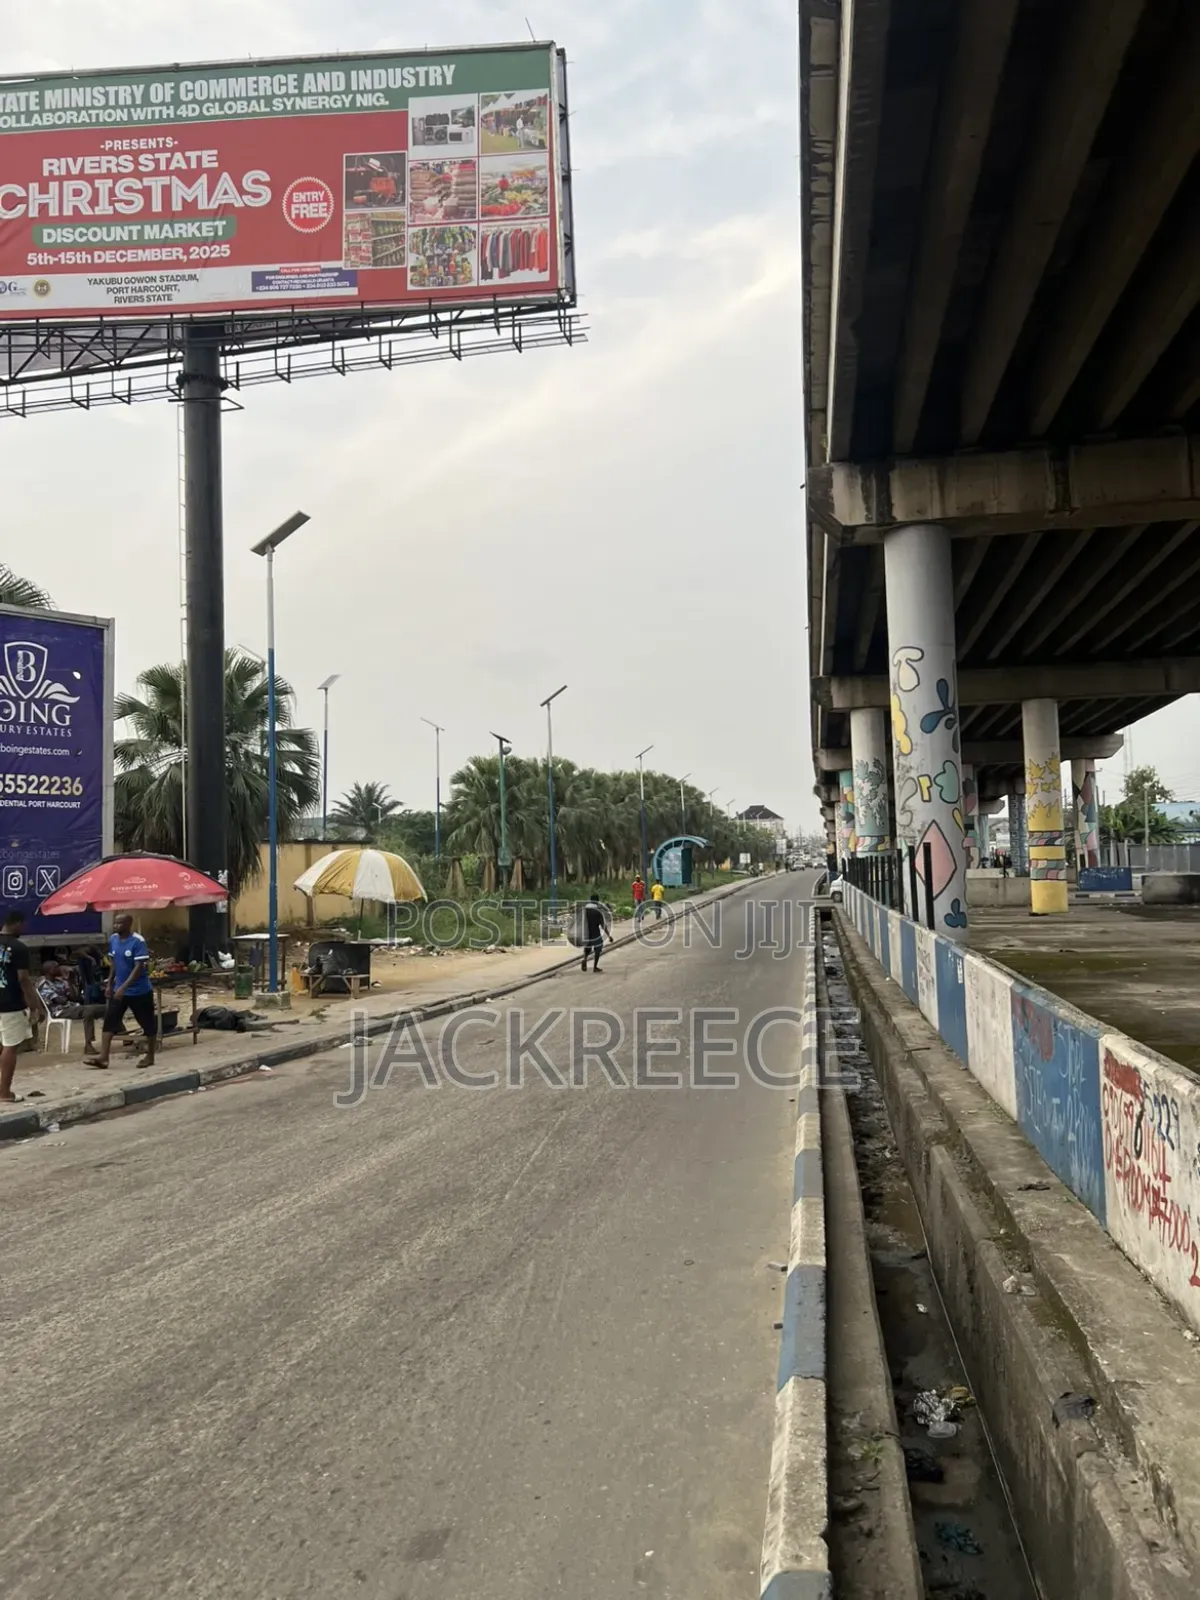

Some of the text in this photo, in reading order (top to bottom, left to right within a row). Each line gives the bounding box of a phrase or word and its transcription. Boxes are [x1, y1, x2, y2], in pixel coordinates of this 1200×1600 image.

[44, 84, 146, 110] MINISTRY
[150, 79, 176, 103] OF
[180, 73, 299, 100] COMMERCE
[302, 70, 346, 94] AND
[351, 64, 456, 91] INDUSTRY
[0, 92, 389, 129] OLLABORATION WITH 4D GLOBAL SYNERGY NIG.
[42, 149, 219, 177] RIVERS STATE
[0, 169, 272, 221] CHRISTMAS
[292, 189, 324, 203] ENTRY
[291, 202, 329, 220] FREE
[42, 219, 227, 245] DISCOUNT MARKET
[27, 244, 231, 267] 5th-15th DECEMBER, 2025
[87, 276, 123, 287] YAKUBU
[124, 275, 158, 286] GOWON
[106, 285, 130, 296] PORT
[114, 292, 173, 305] RIVERS STATE
[26, 725, 72, 738] ESTATES
[0, 743, 70, 756] boingestates.com
[28, 800, 45, 808] PORT
[46, 801, 81, 809] HARCOURT
